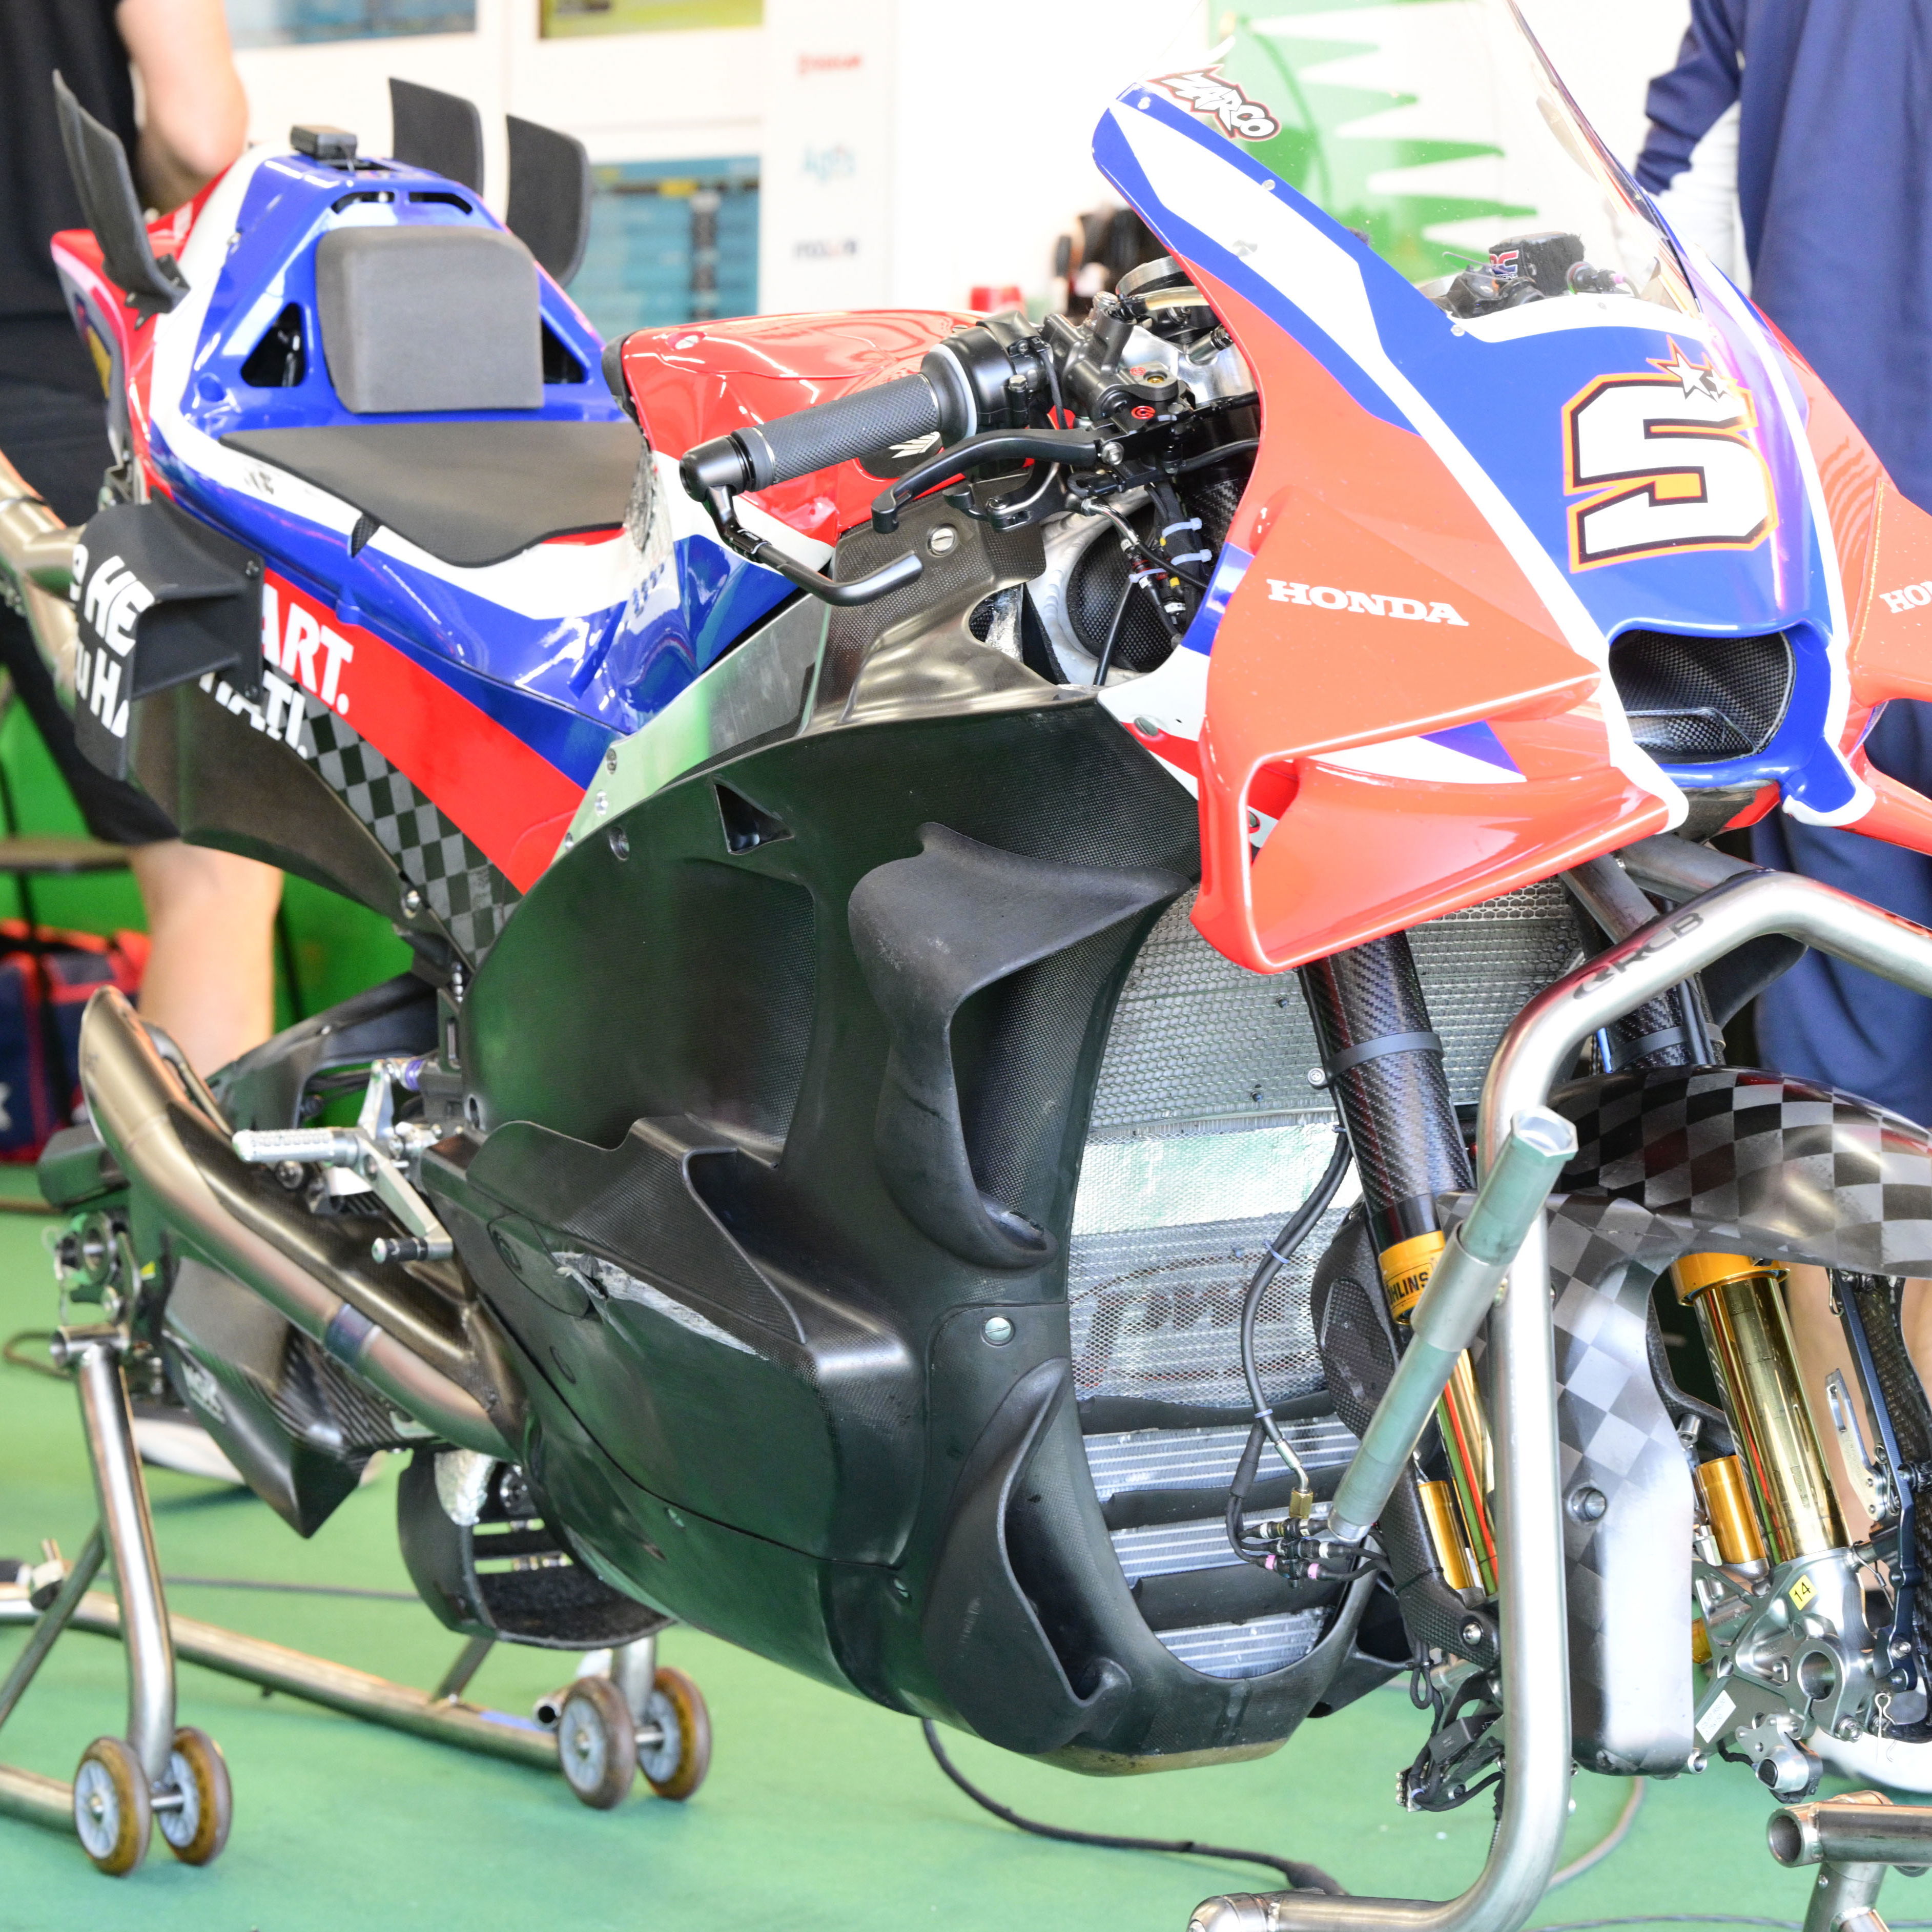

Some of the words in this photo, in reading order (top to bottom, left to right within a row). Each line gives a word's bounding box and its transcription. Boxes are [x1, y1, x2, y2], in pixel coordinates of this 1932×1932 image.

[1157, 71, 1276, 138] ZARCO
[1561, 372, 1780, 574] 5
[1266, 579, 1469, 626] HONDA
[1794, 1582, 1811, 1601] 14
